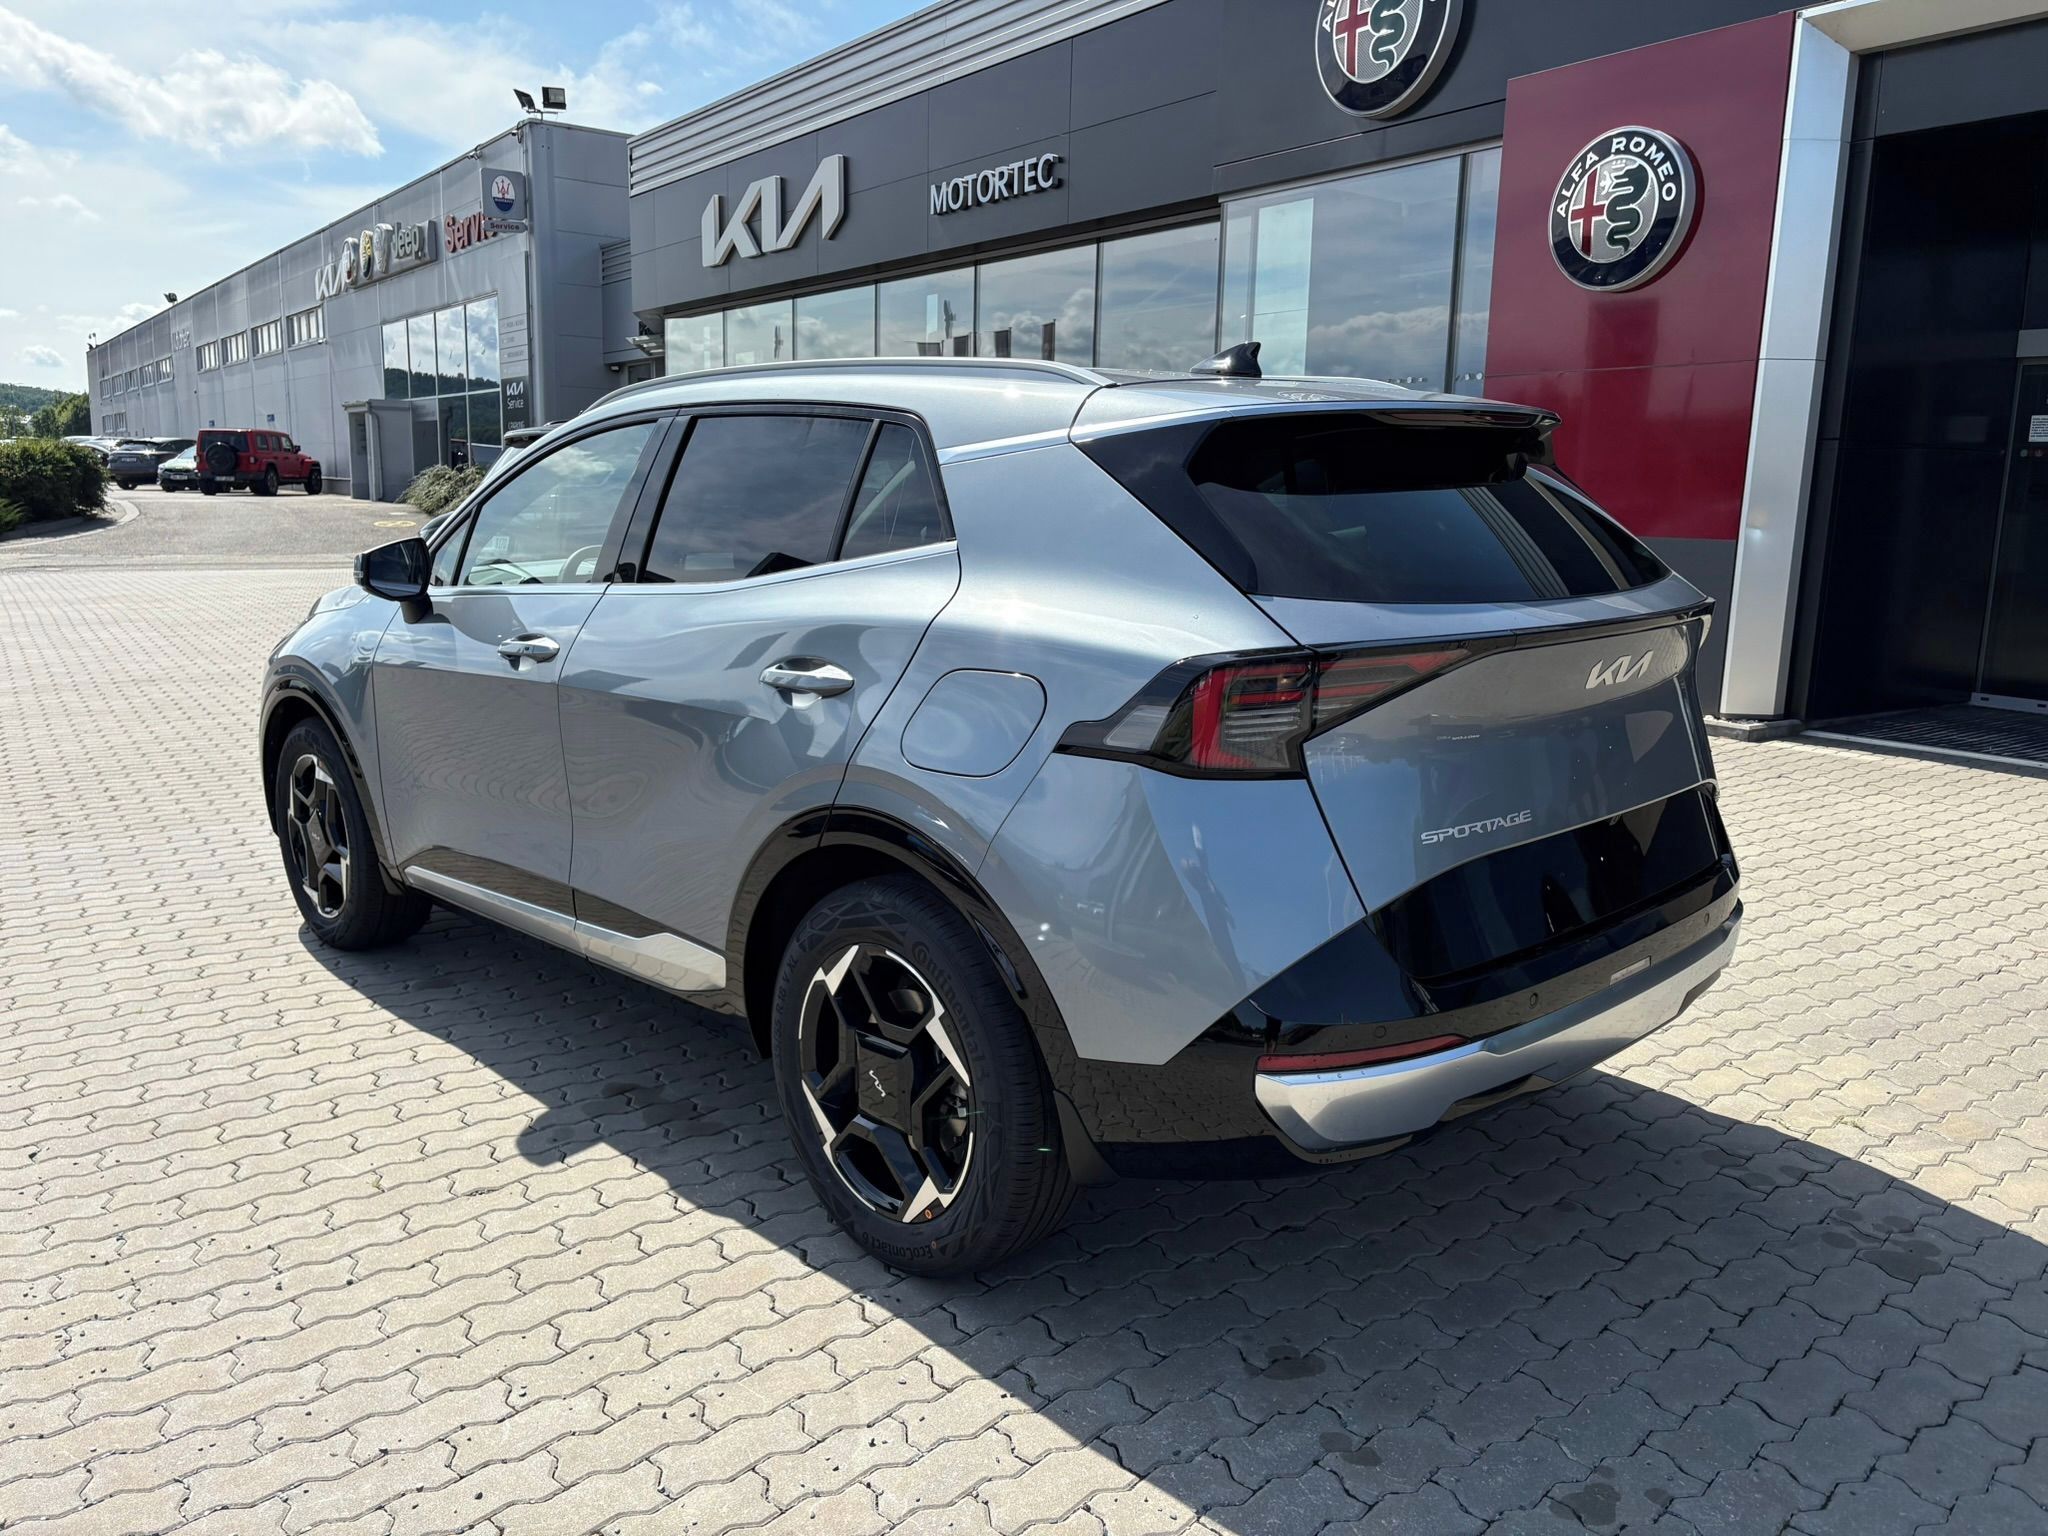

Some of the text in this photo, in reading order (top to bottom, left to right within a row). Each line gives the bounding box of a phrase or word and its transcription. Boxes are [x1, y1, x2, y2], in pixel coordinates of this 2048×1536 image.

[930, 153, 1057, 215] MOTORTEC
[1556, 136, 1677, 218] ALFA ROMEO
[490, 222, 520, 231] Service
[702, 154, 844, 267] KIA
[445, 213, 497, 252] Servi
[506, 380, 524, 396] KIA
[506, 397, 524, 407] Service
[1584, 649, 1654, 689] KIA
[1420, 809, 1532, 844] SPORTAGE
[911, 940, 985, 1061] Continental
